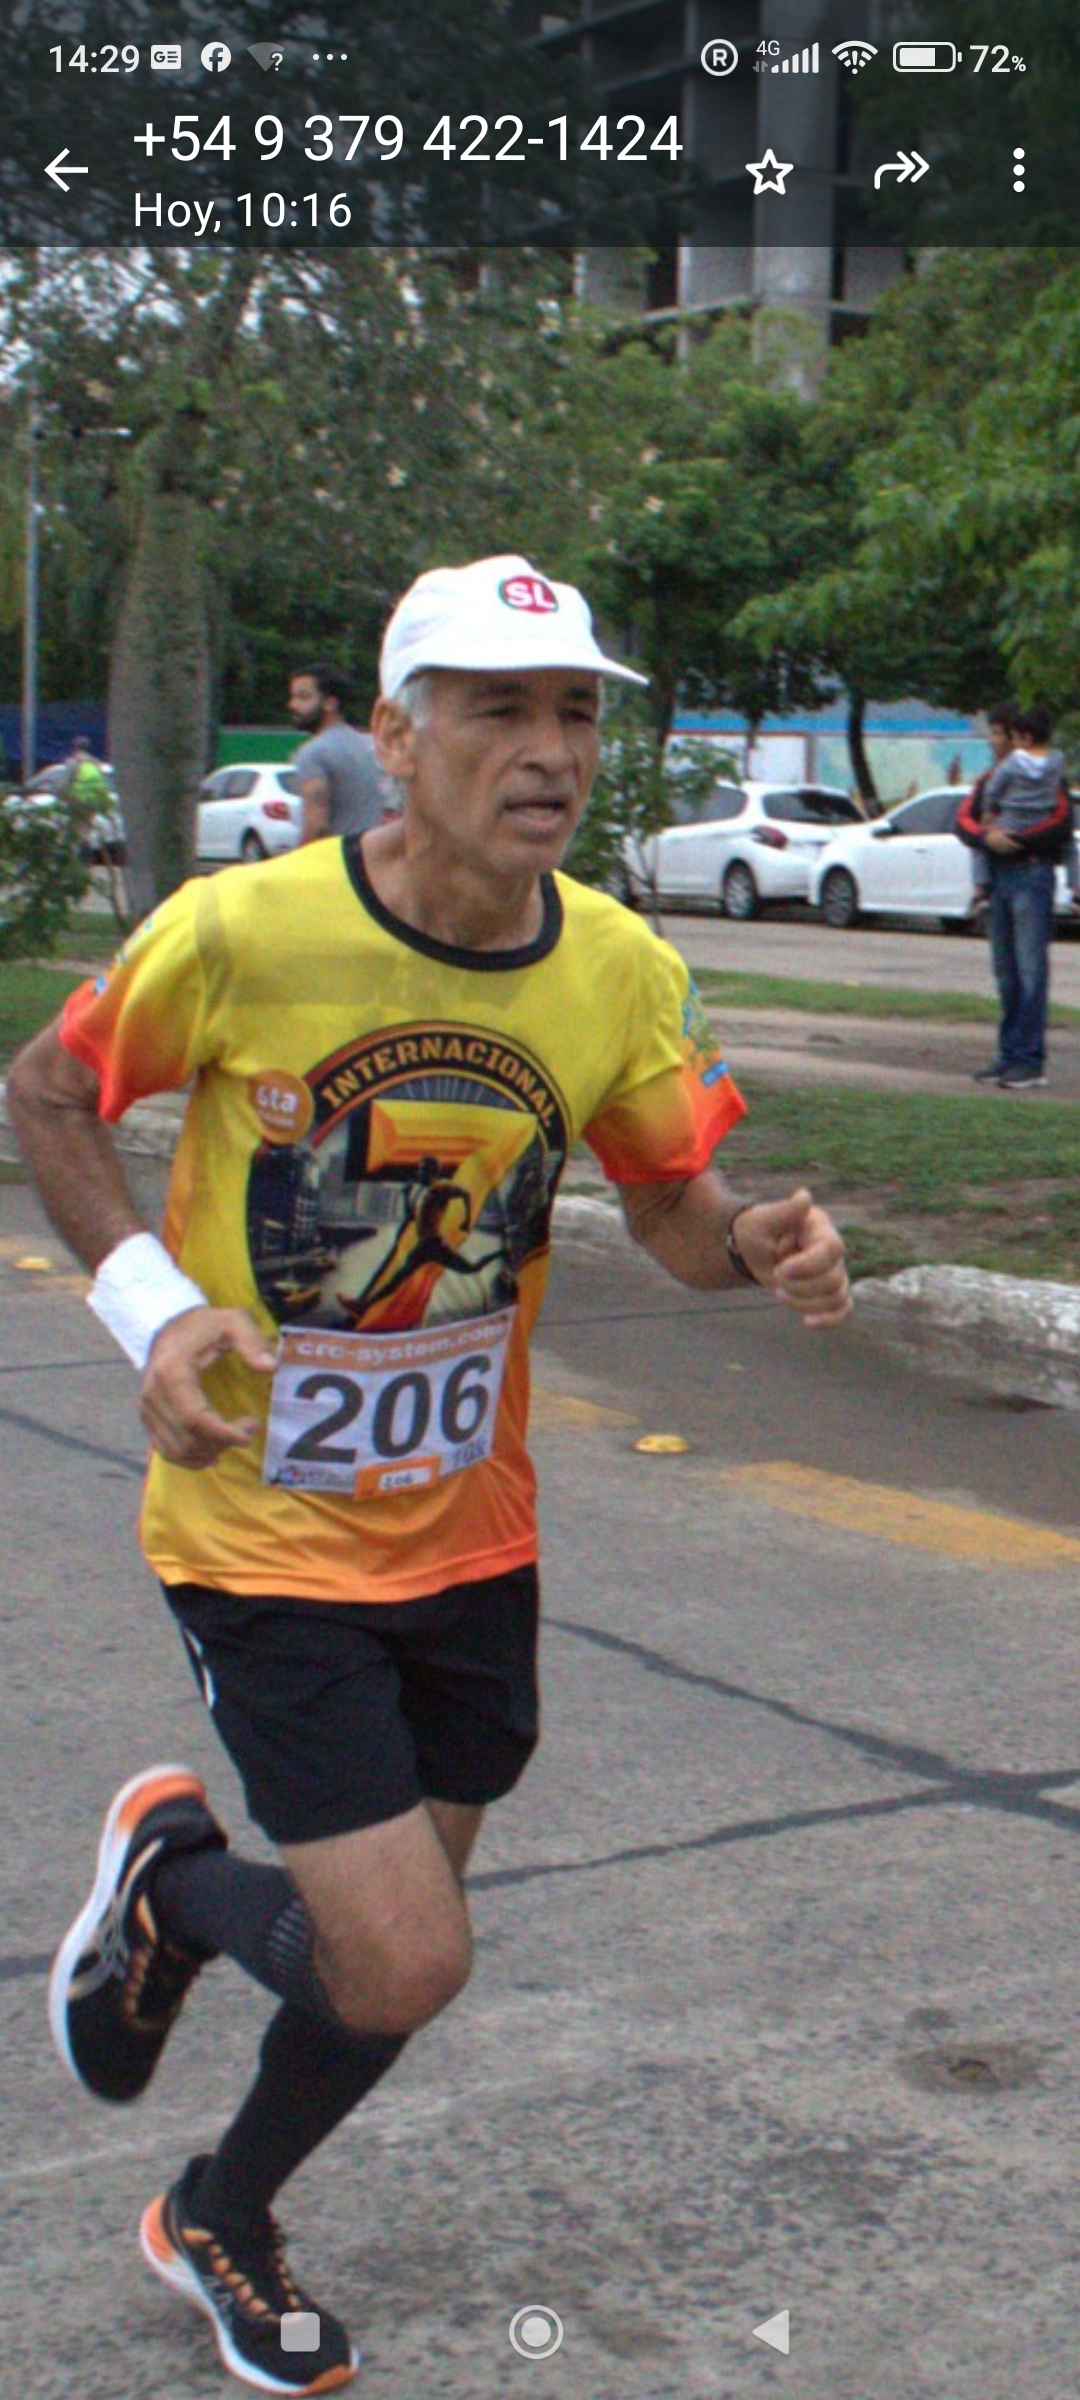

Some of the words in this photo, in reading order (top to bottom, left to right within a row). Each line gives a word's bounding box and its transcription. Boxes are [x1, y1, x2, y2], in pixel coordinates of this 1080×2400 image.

[505, 581, 556, 609] SL
[321, 1035, 558, 1128] INTERNACIONAL
[286, 1353, 492, 1464] 206
